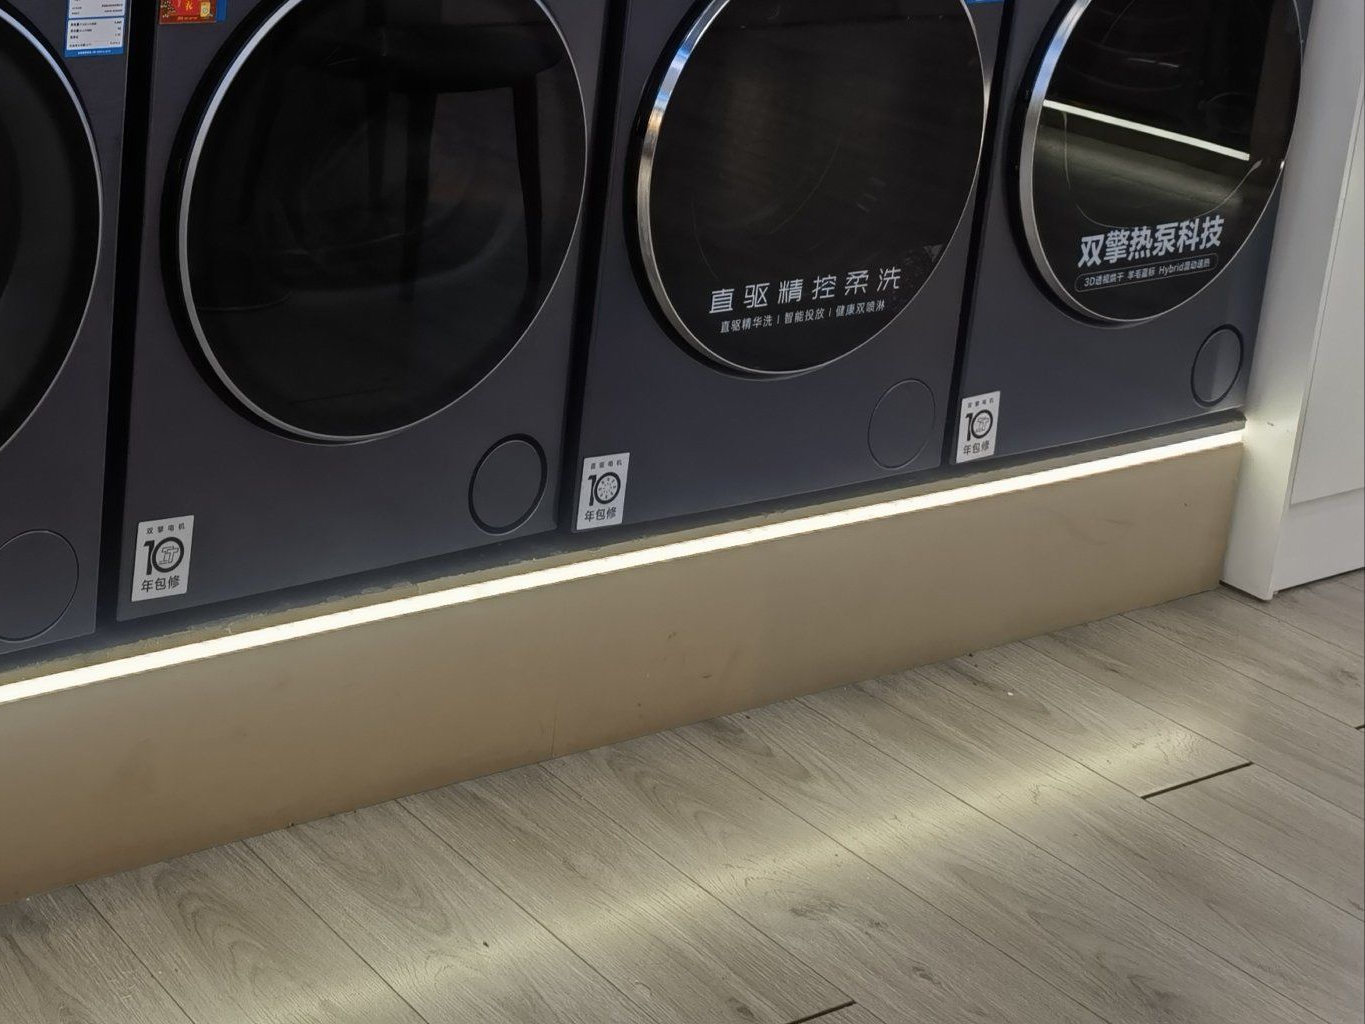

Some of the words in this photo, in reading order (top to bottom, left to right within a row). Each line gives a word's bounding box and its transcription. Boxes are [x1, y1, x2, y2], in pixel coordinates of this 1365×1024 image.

[1077, 214, 1225, 269] 双擎热泵科技
[708, 266, 902, 315] 直驱精控柔洗
[720, 316, 774, 334] 直驱精华洗
[784, 308, 825, 325] 智能投放
[835, 299, 886, 318] 健康双喷淋
[963, 440, 990, 456] 年包修
[584, 506, 617, 523] 年包修
[140, 575, 181, 593] 年包修
